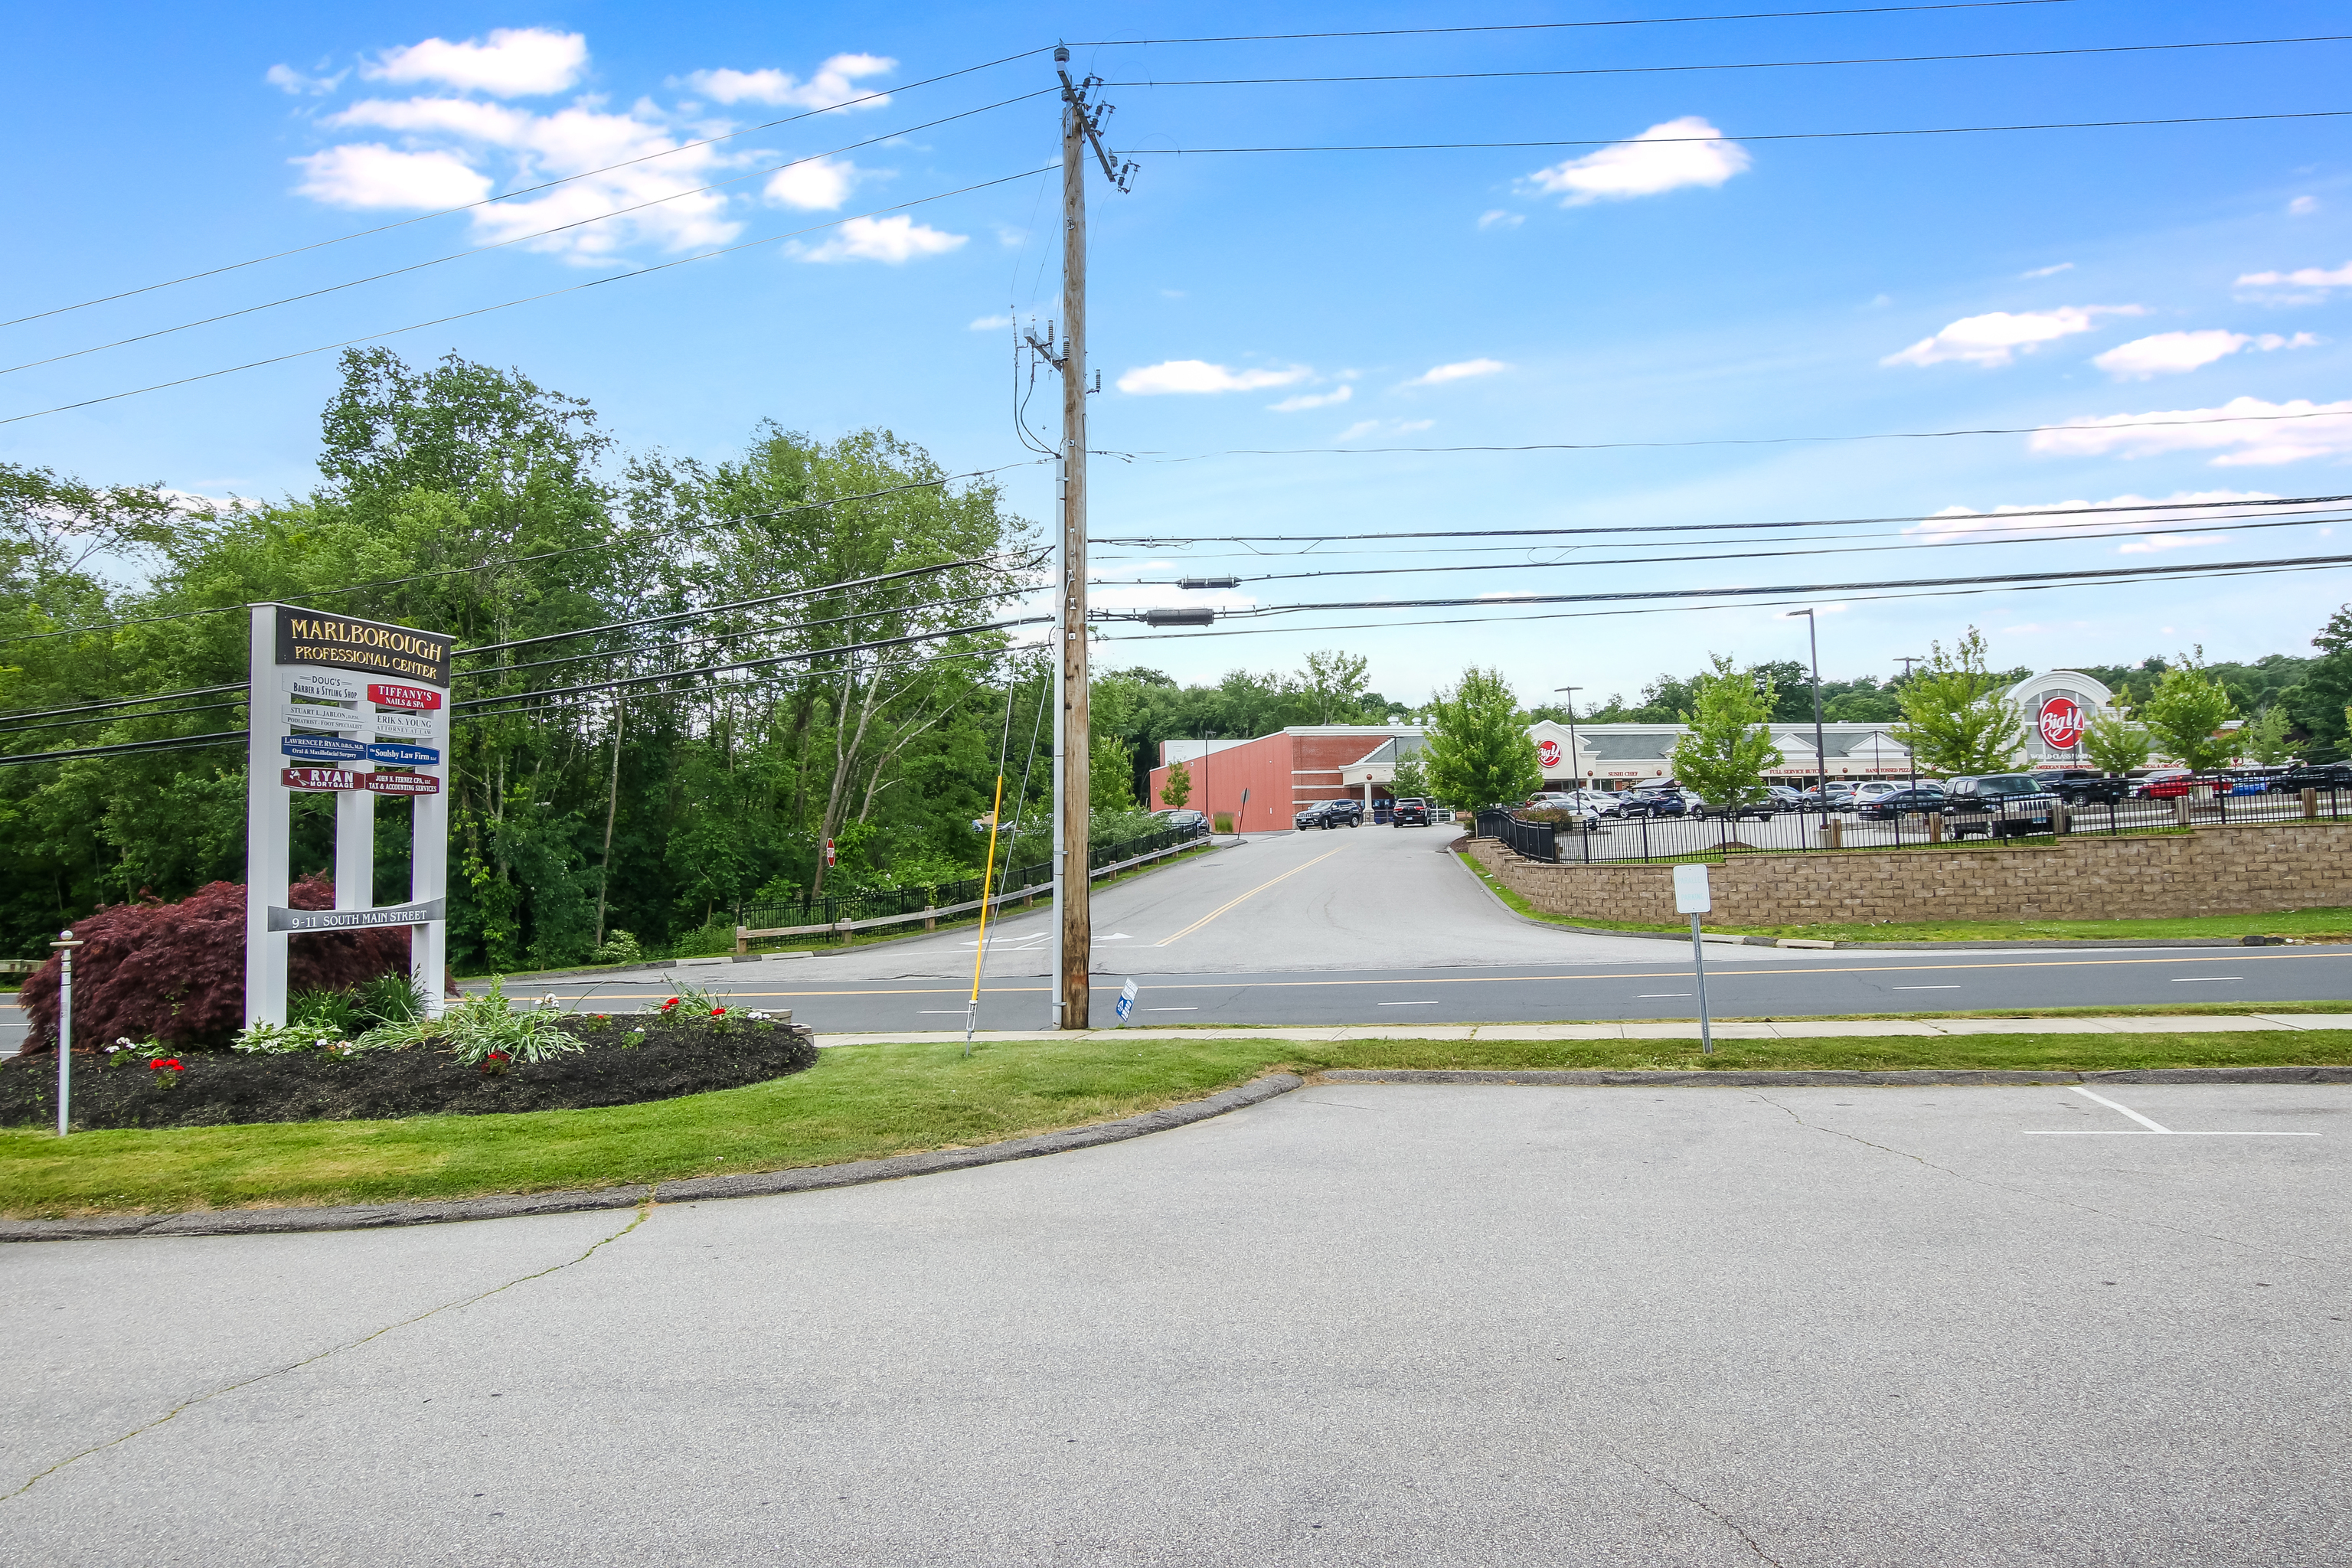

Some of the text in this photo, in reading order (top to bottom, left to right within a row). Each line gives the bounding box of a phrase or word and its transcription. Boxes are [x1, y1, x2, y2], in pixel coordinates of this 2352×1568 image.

[291, 619, 443, 662] MARLBOROUGH
[295, 646, 436, 679] PROFESSIONAL CENTER
[312, 675, 340, 686] DOUG'S
[294, 682, 314, 694] BARBER
[322, 686, 341, 697] STYLING
[345, 689, 357, 699] SHOP
[378, 686, 432, 701] TIFFANY'S
[386, 697, 405, 706] NAILS
[322, 710, 348, 719] JABLON,
[287, 717, 317, 725] PODIATRIST
[377, 715, 396, 724] ERIK
[406, 718, 431, 727] YOUNG
[285, 737, 318, 746] LAWRENCE
[375, 749, 399, 760] Soulsby
[400, 750, 413, 759] Law
[414, 752, 430, 760] Firm
[311, 769, 354, 782] RYAN
[1677, 876, 1704, 884] PARALLEL
[292, 910, 427, 929] 9-11 SOUTH MAIN STREET
